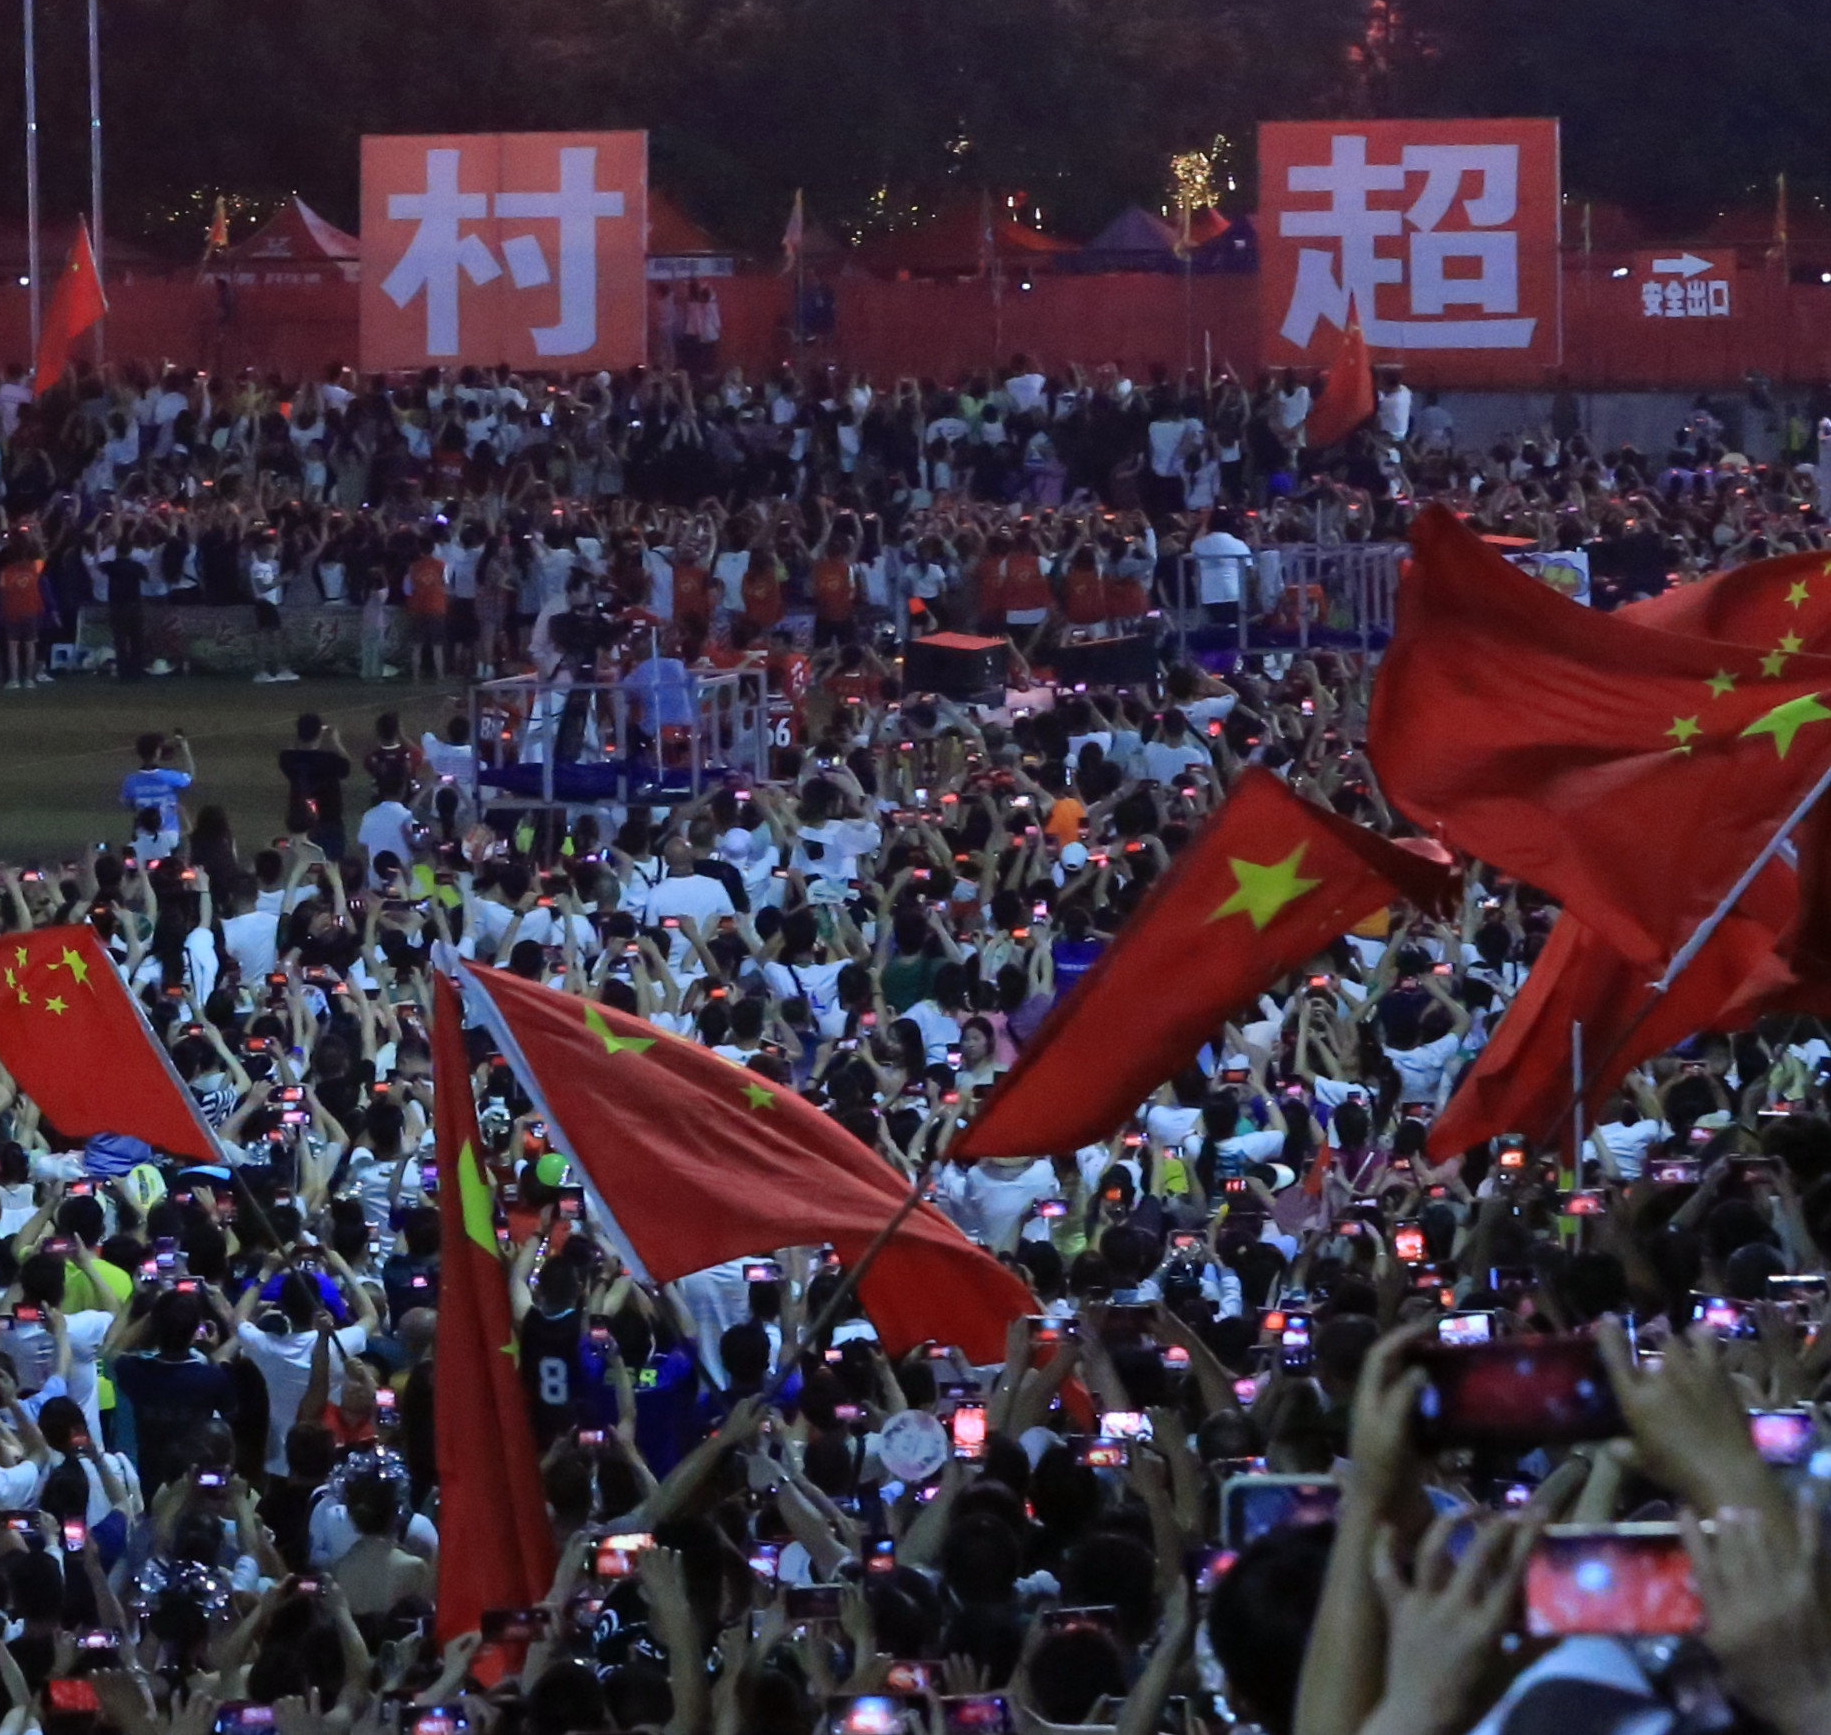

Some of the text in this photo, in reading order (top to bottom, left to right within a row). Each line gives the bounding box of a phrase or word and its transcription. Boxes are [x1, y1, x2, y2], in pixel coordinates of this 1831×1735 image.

[380, 146, 624, 357] 村
[1280, 134, 1537, 349] 超
[1642, 279, 1730, 318] 安全出口
[539, 1356, 568, 1405] 8
